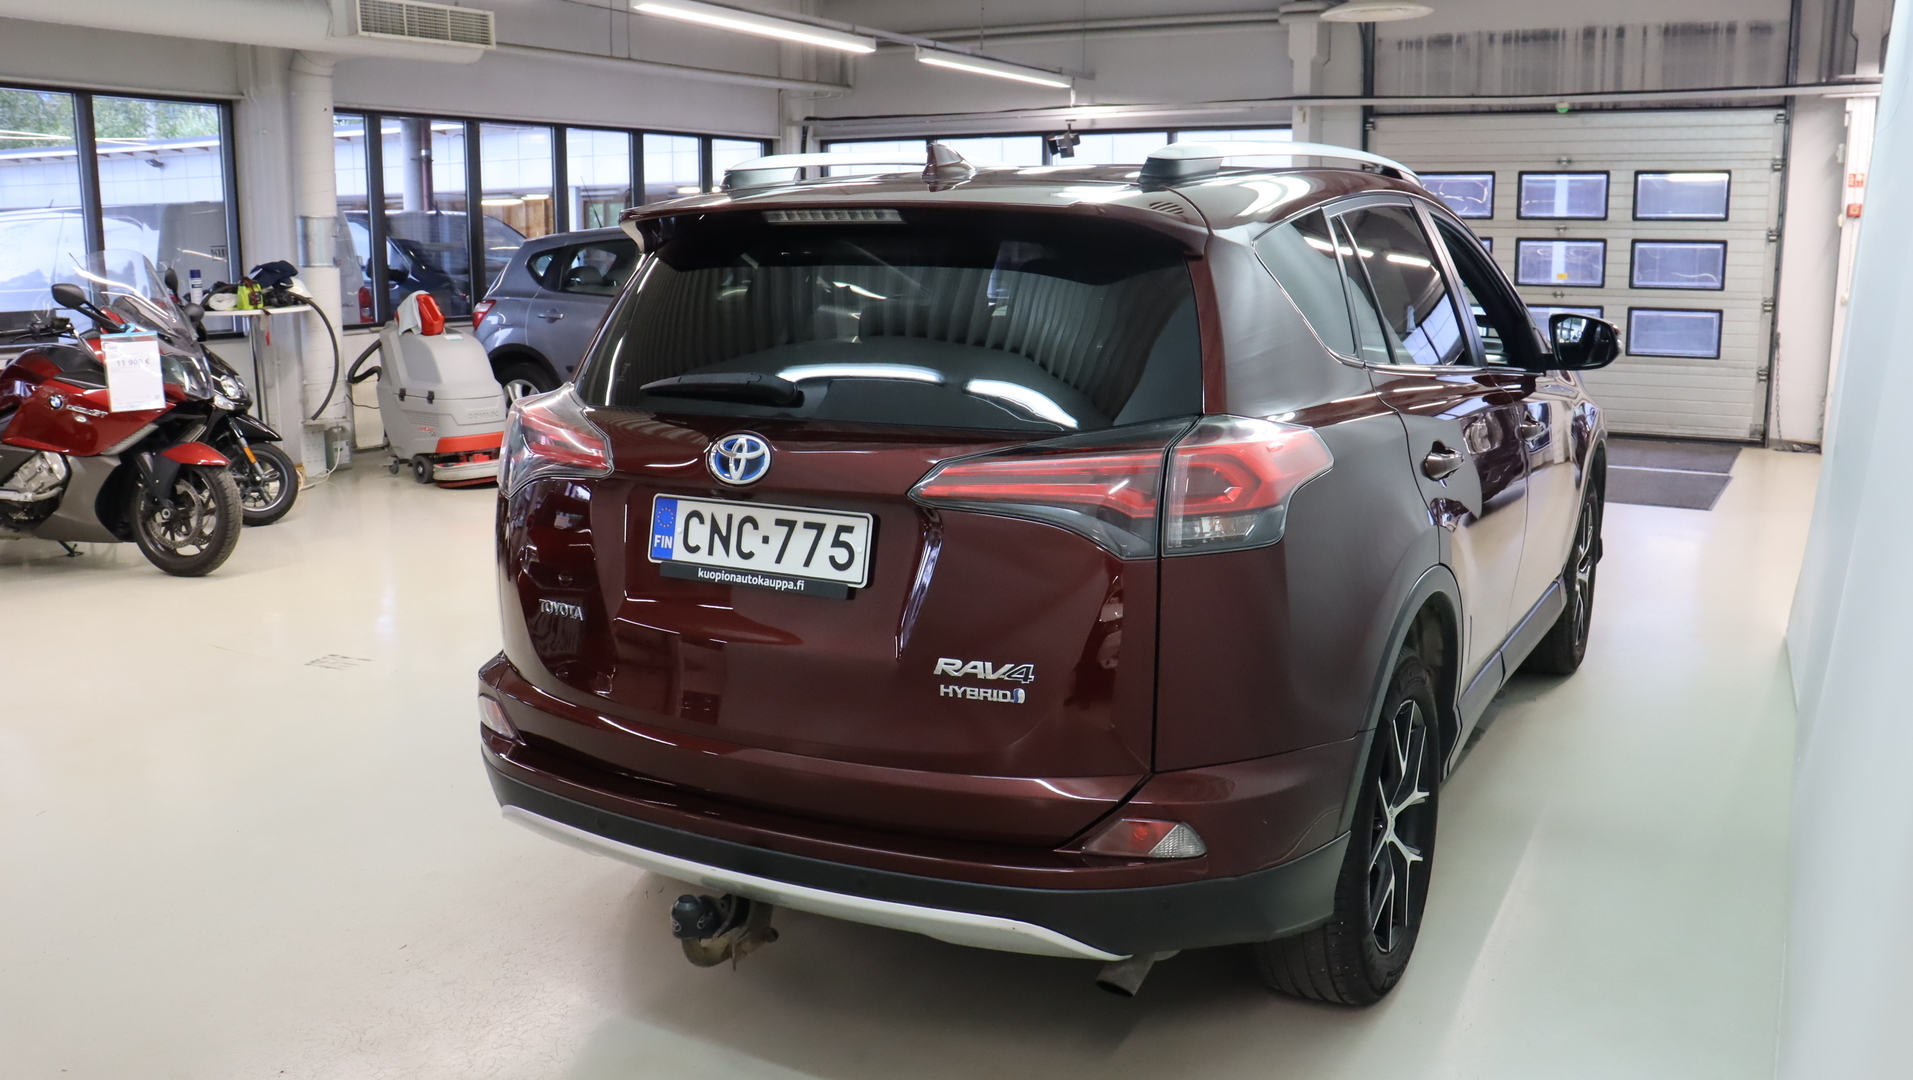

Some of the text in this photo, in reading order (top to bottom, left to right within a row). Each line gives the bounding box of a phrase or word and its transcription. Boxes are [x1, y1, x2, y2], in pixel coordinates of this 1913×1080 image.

[654, 534, 673, 549] FIN
[697, 567, 805, 591] kuopionautokauppa.fi
[539, 598, 584, 621] TOYOTA
[932, 657, 1035, 684] RAV4
[939, 684, 1012, 703] HYBRID
